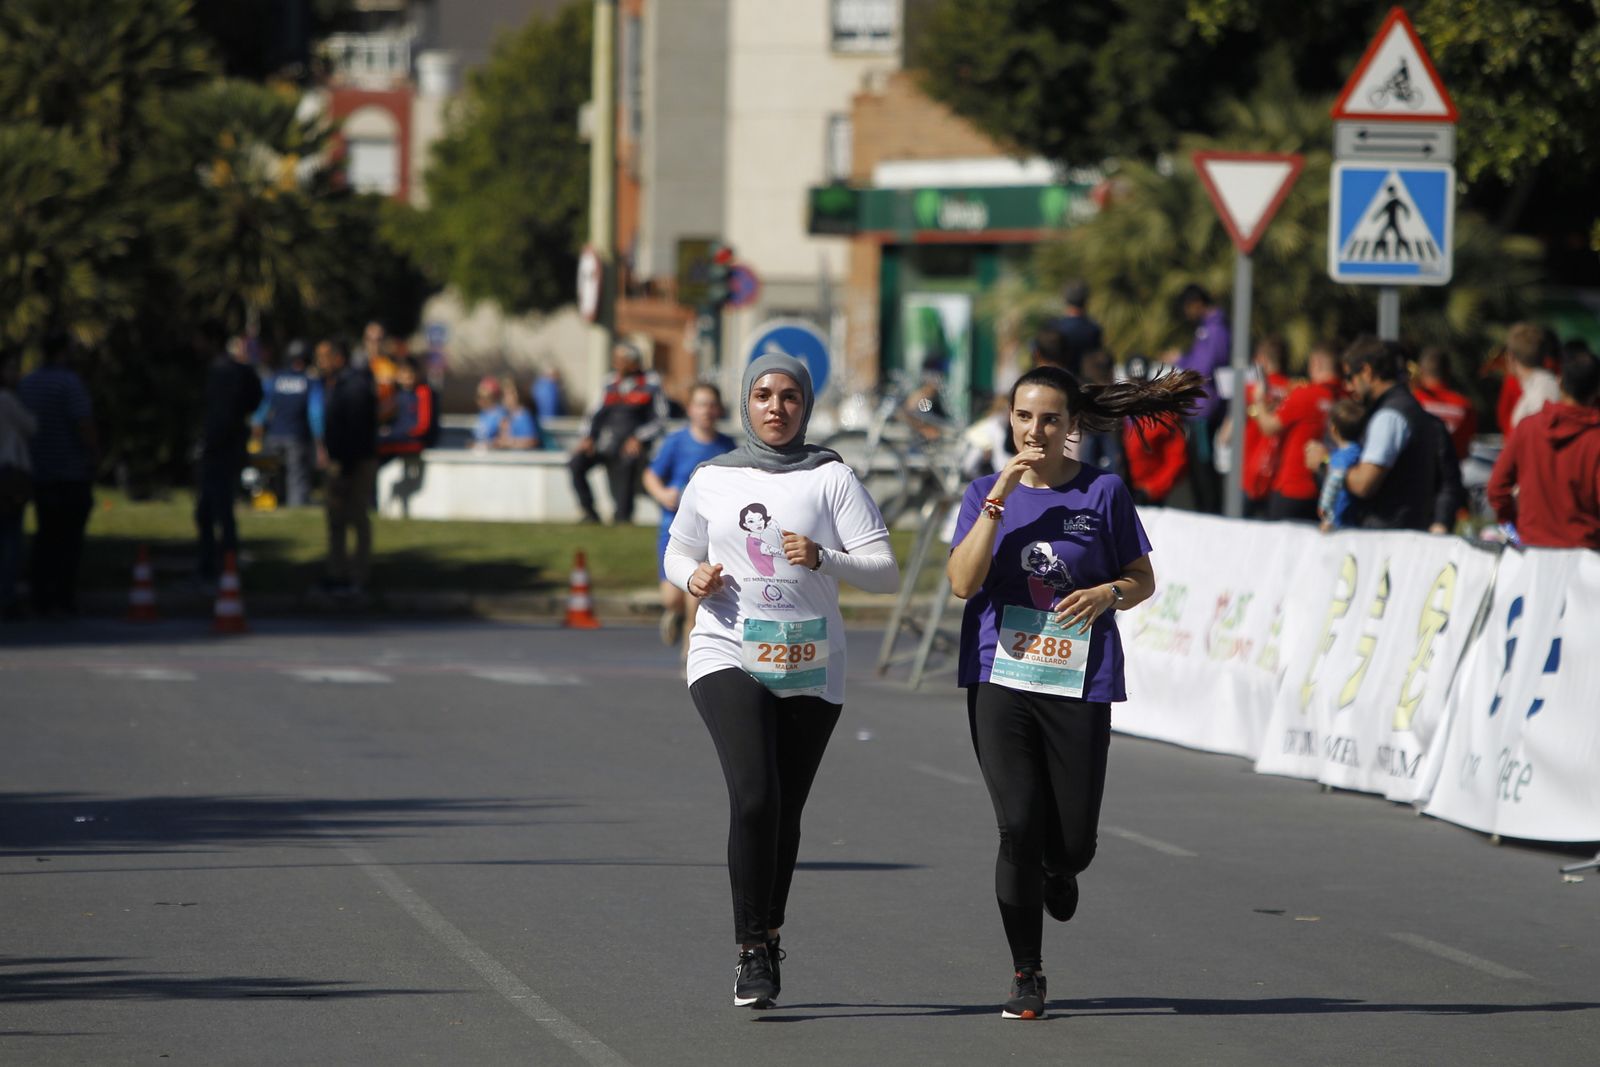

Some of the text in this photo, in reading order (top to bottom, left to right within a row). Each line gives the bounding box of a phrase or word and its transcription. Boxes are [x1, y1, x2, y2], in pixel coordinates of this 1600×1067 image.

[757, 643, 816, 663] 2289
[1012, 631, 1072, 659] 2288
[1031, 655, 1068, 666] GALLARDO
